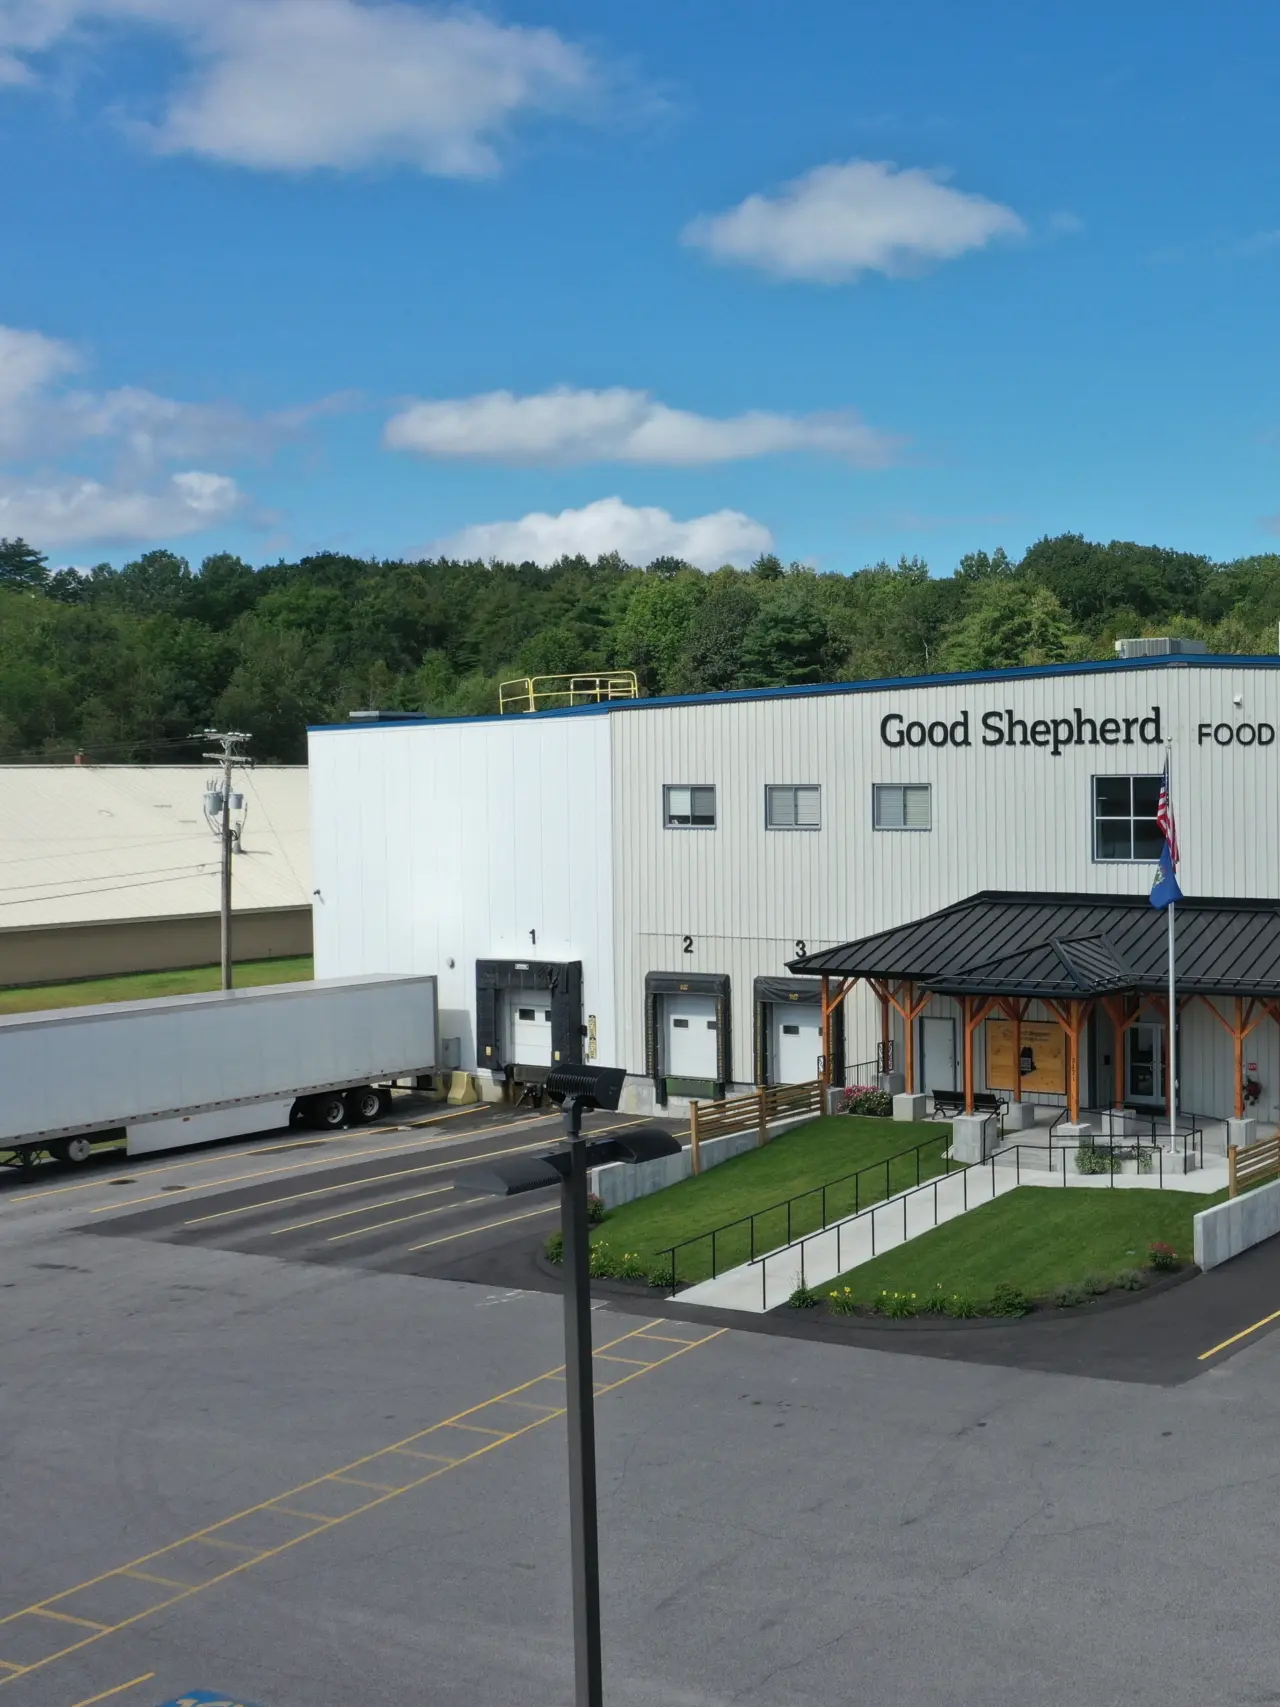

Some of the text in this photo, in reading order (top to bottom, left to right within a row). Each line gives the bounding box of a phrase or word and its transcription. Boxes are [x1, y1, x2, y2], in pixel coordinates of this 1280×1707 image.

[881, 705, 1164, 757] Good Shepherd
[1197, 721, 1276, 748] FOOD
[528, 928, 537, 945] 1
[683, 935, 694, 954] 2
[795, 939, 807, 959] 3
